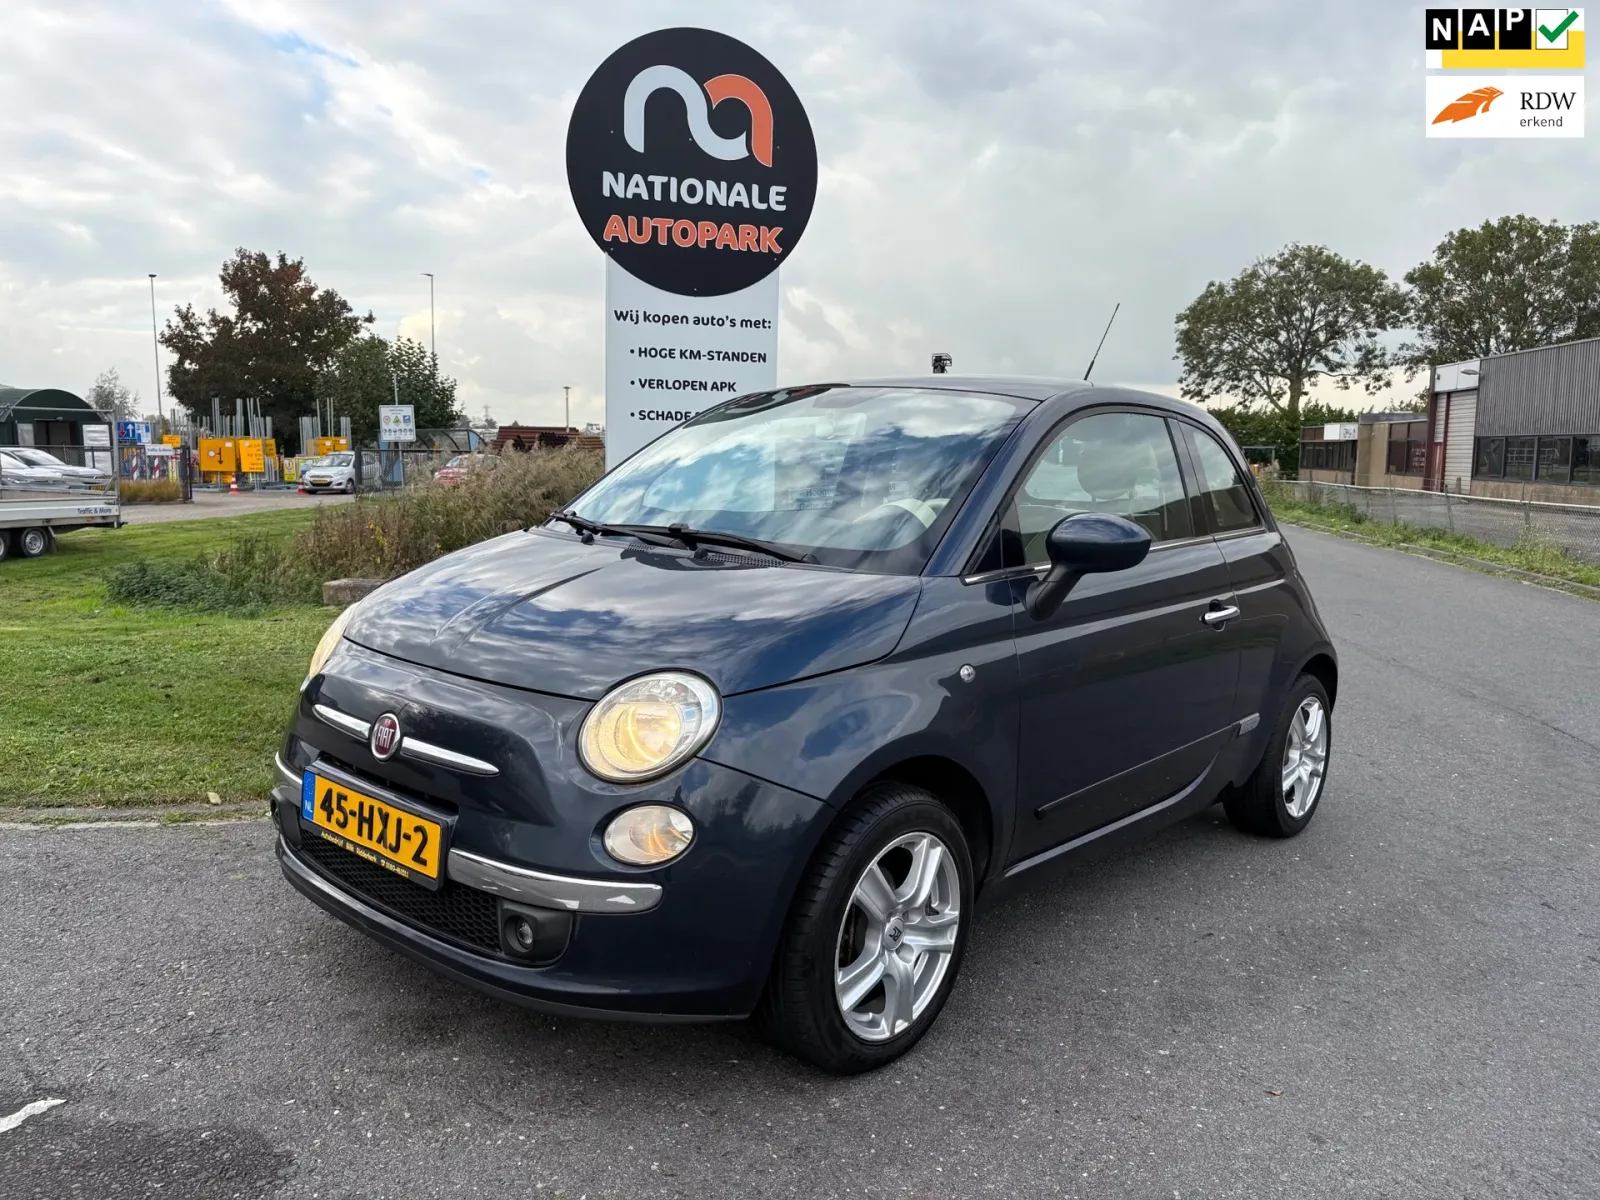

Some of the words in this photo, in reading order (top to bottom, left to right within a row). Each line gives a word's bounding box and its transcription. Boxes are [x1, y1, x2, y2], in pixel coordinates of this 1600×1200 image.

[602, 170, 787, 211] NATIONALE
[602, 214, 783, 254] AUTOPARK
[614, 309, 639, 325] Wij
[643, 310, 689, 326] kopen
[692, 315, 736, 328] auto's
[740, 318, 772, 330] met:
[638, 347, 676, 359] HOGE
[679, 349, 767, 363] KM-STANDEN
[638, 378, 708, 391] VERLOPEN
[710, 382, 737, 392] APK
[638, 410, 692, 421] SCHADE
[375, 725, 395, 748] FIAT
[304, 799, 313, 813] NL
[320, 787, 428, 867] 45-HXJ-2
